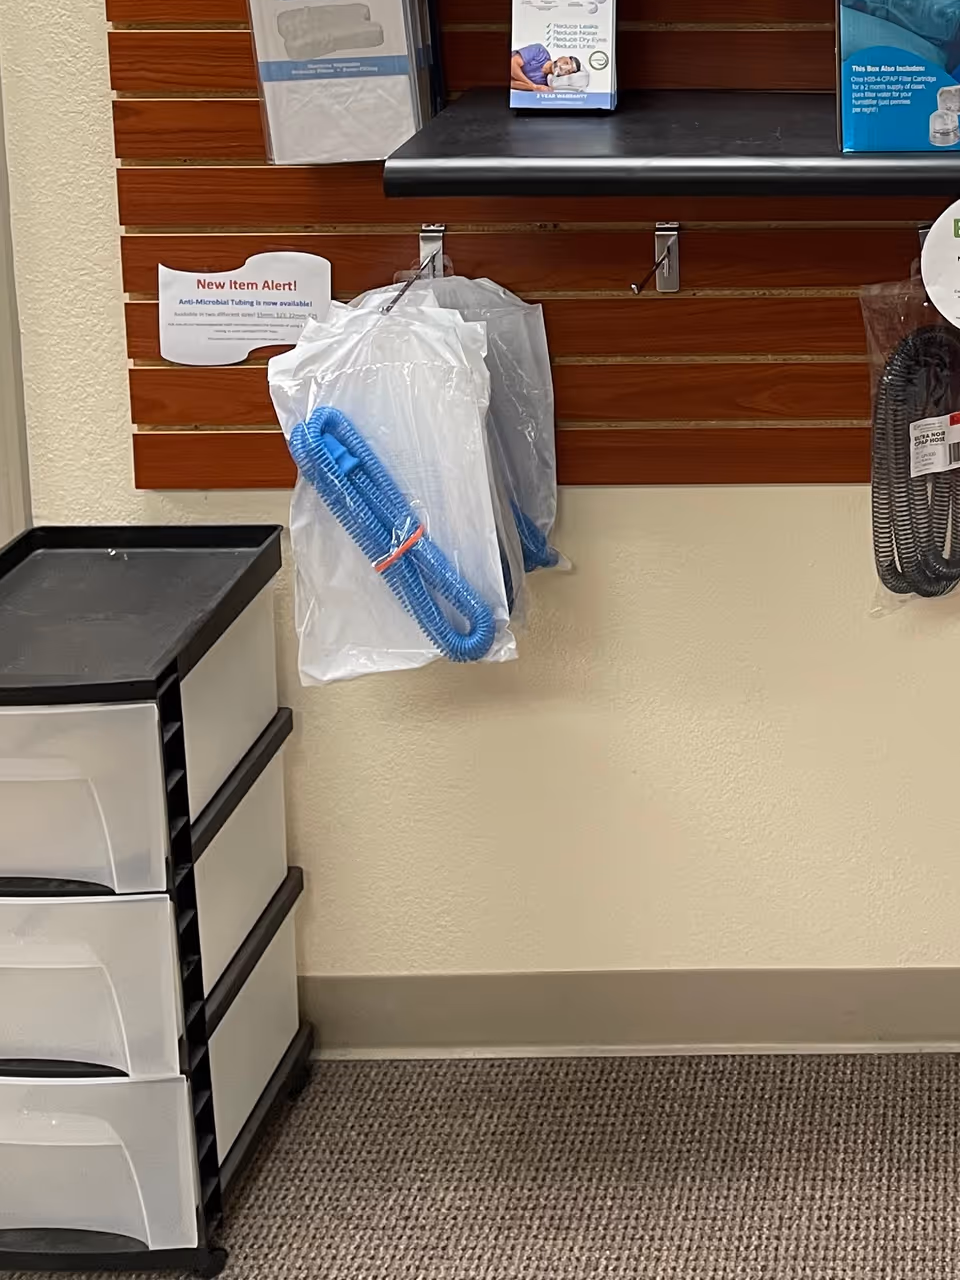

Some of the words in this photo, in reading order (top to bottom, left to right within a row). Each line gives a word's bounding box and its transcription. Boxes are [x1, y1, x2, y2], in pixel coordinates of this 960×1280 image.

[196, 278, 226, 289] New
[229, 279, 258, 290] Item
[261, 280, 297, 291] Alert!
[178, 298, 229, 306] Anti-Microbial
[230, 299, 254, 308] Tubing
[279, 300, 313, 308] available!
